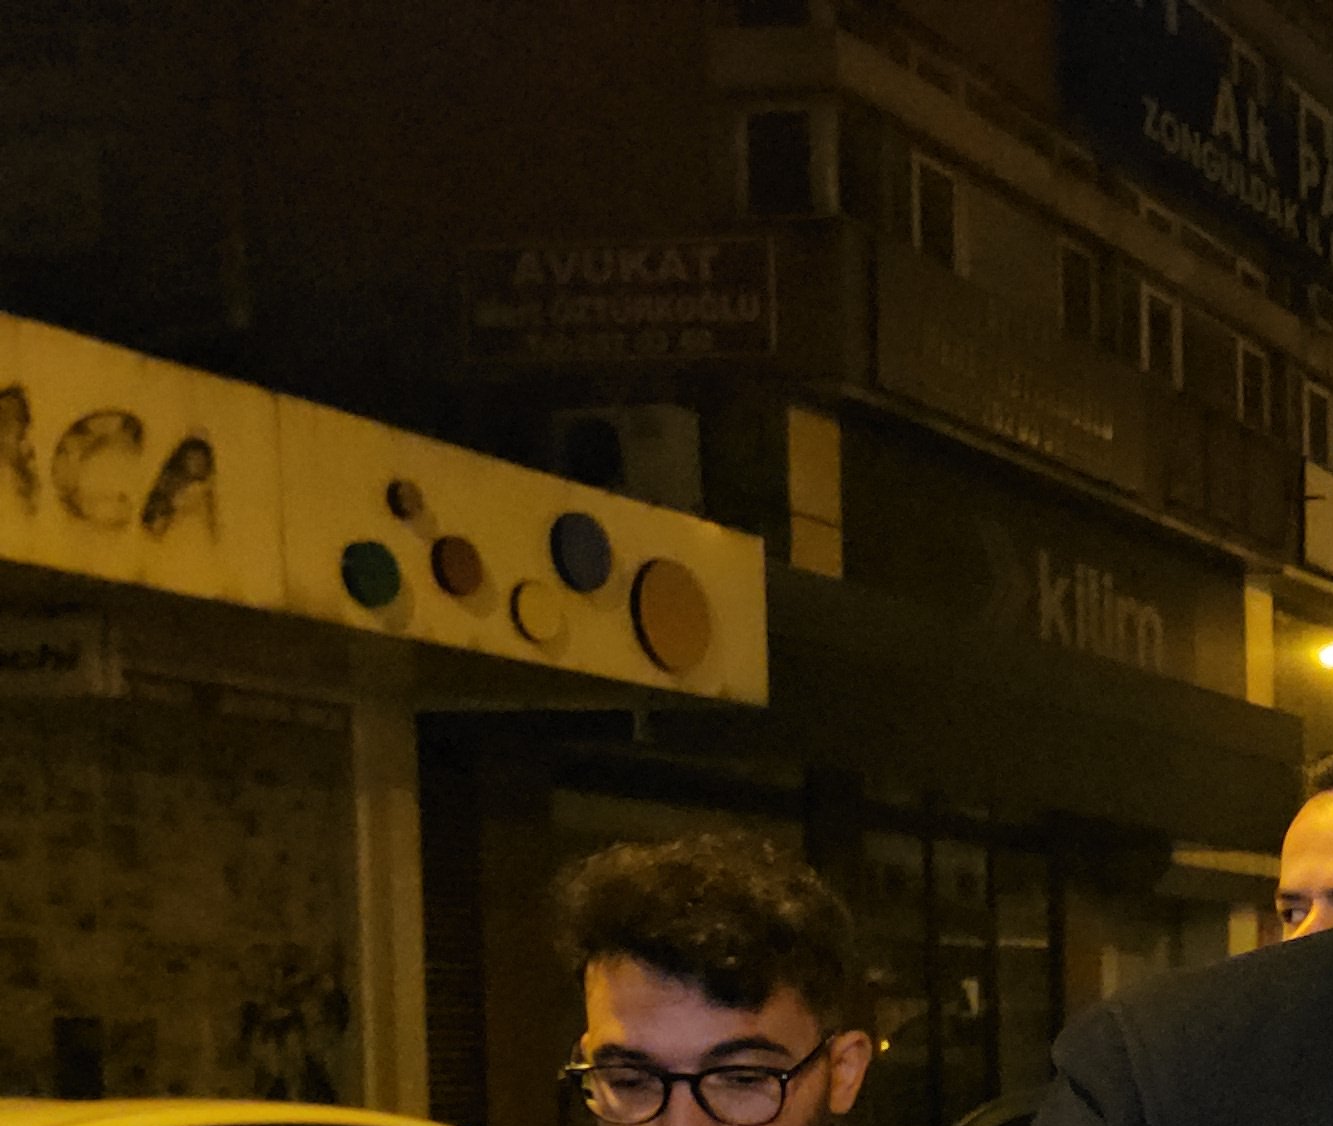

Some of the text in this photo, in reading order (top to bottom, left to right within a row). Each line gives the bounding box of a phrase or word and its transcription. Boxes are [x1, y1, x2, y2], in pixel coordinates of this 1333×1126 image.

[1141, 94, 1301, 240] ZONGULDAK
[1212, 75, 1278, 180] AK
[511, 245, 721, 286] AVUKAT
[1037, 548, 1165, 675] kilim
